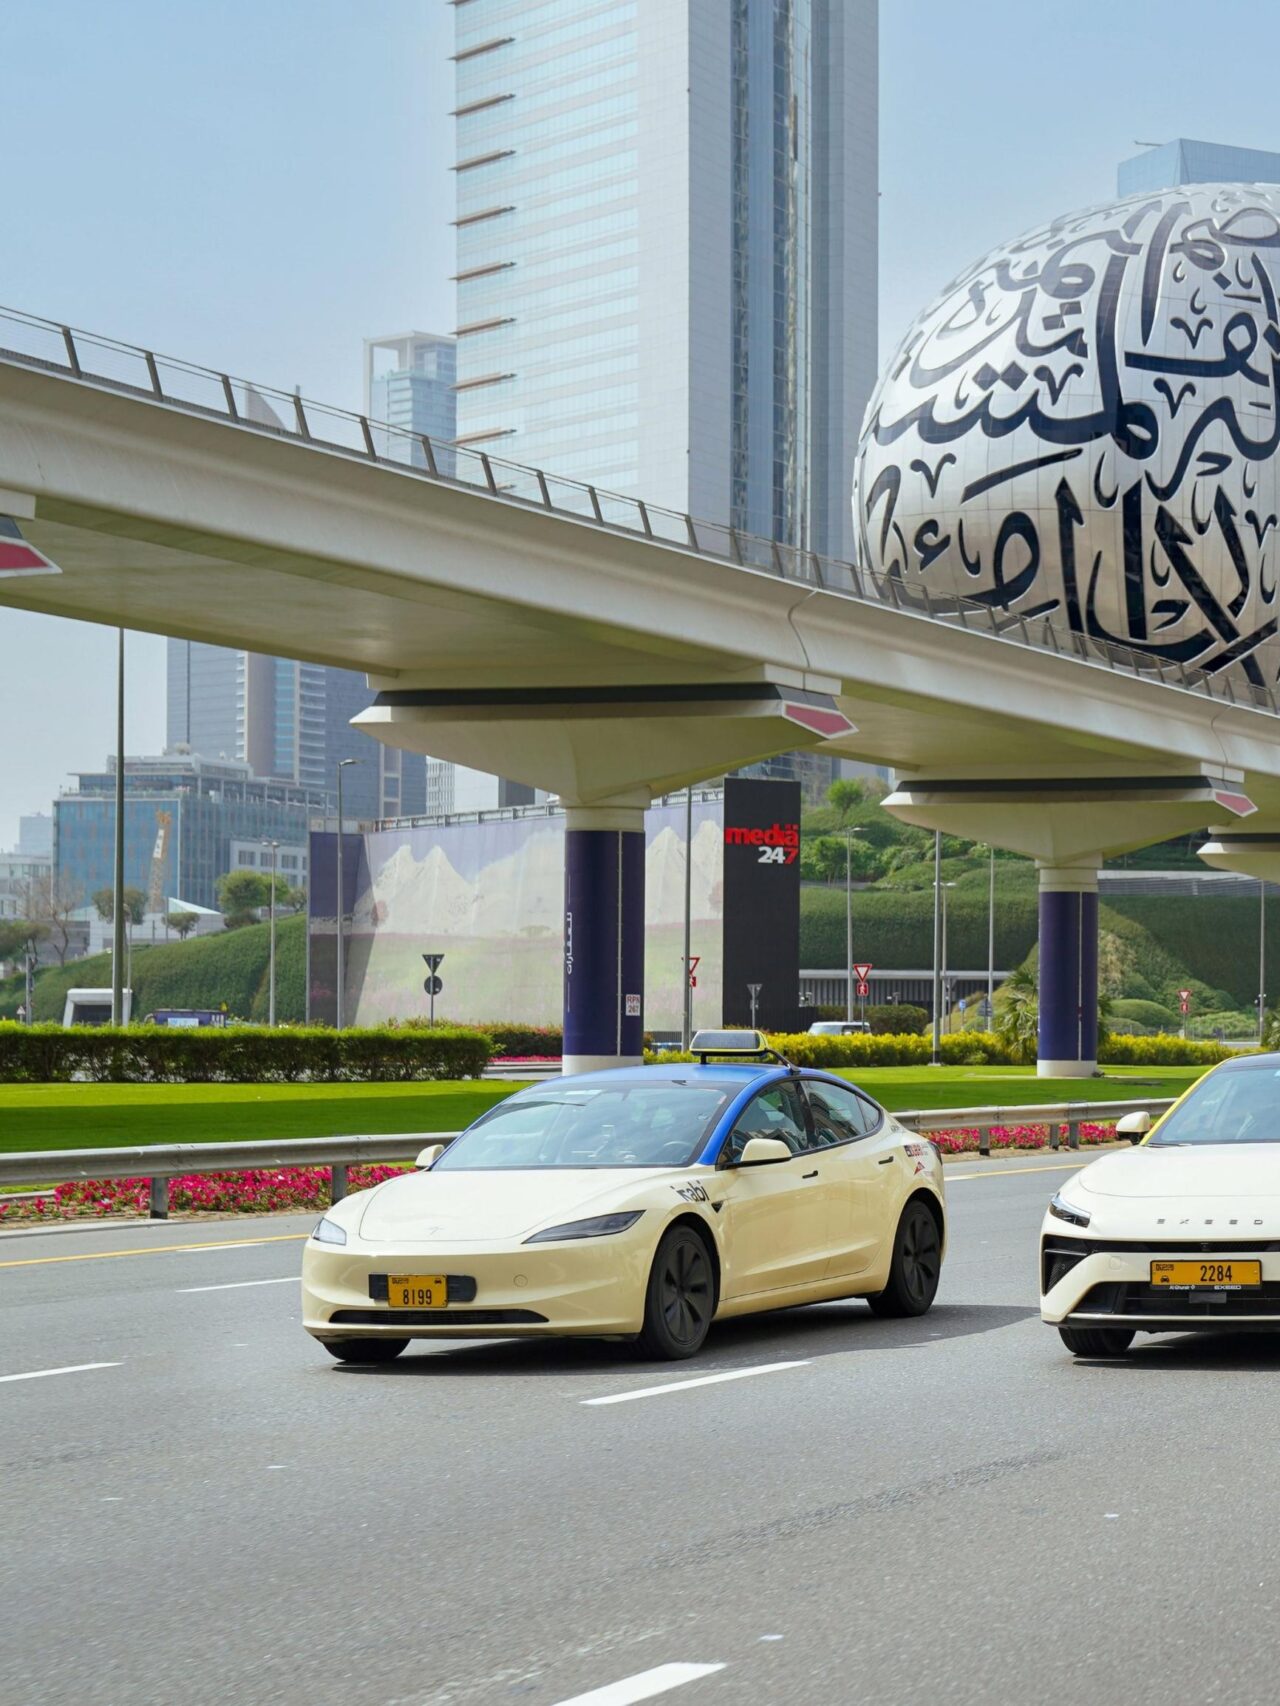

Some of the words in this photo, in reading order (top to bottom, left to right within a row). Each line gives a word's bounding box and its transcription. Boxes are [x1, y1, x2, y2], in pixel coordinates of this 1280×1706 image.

[757, 846, 799, 865] 247
[1199, 1265, 1233, 1282] 2284
[402, 1288, 433, 1305] 8199
